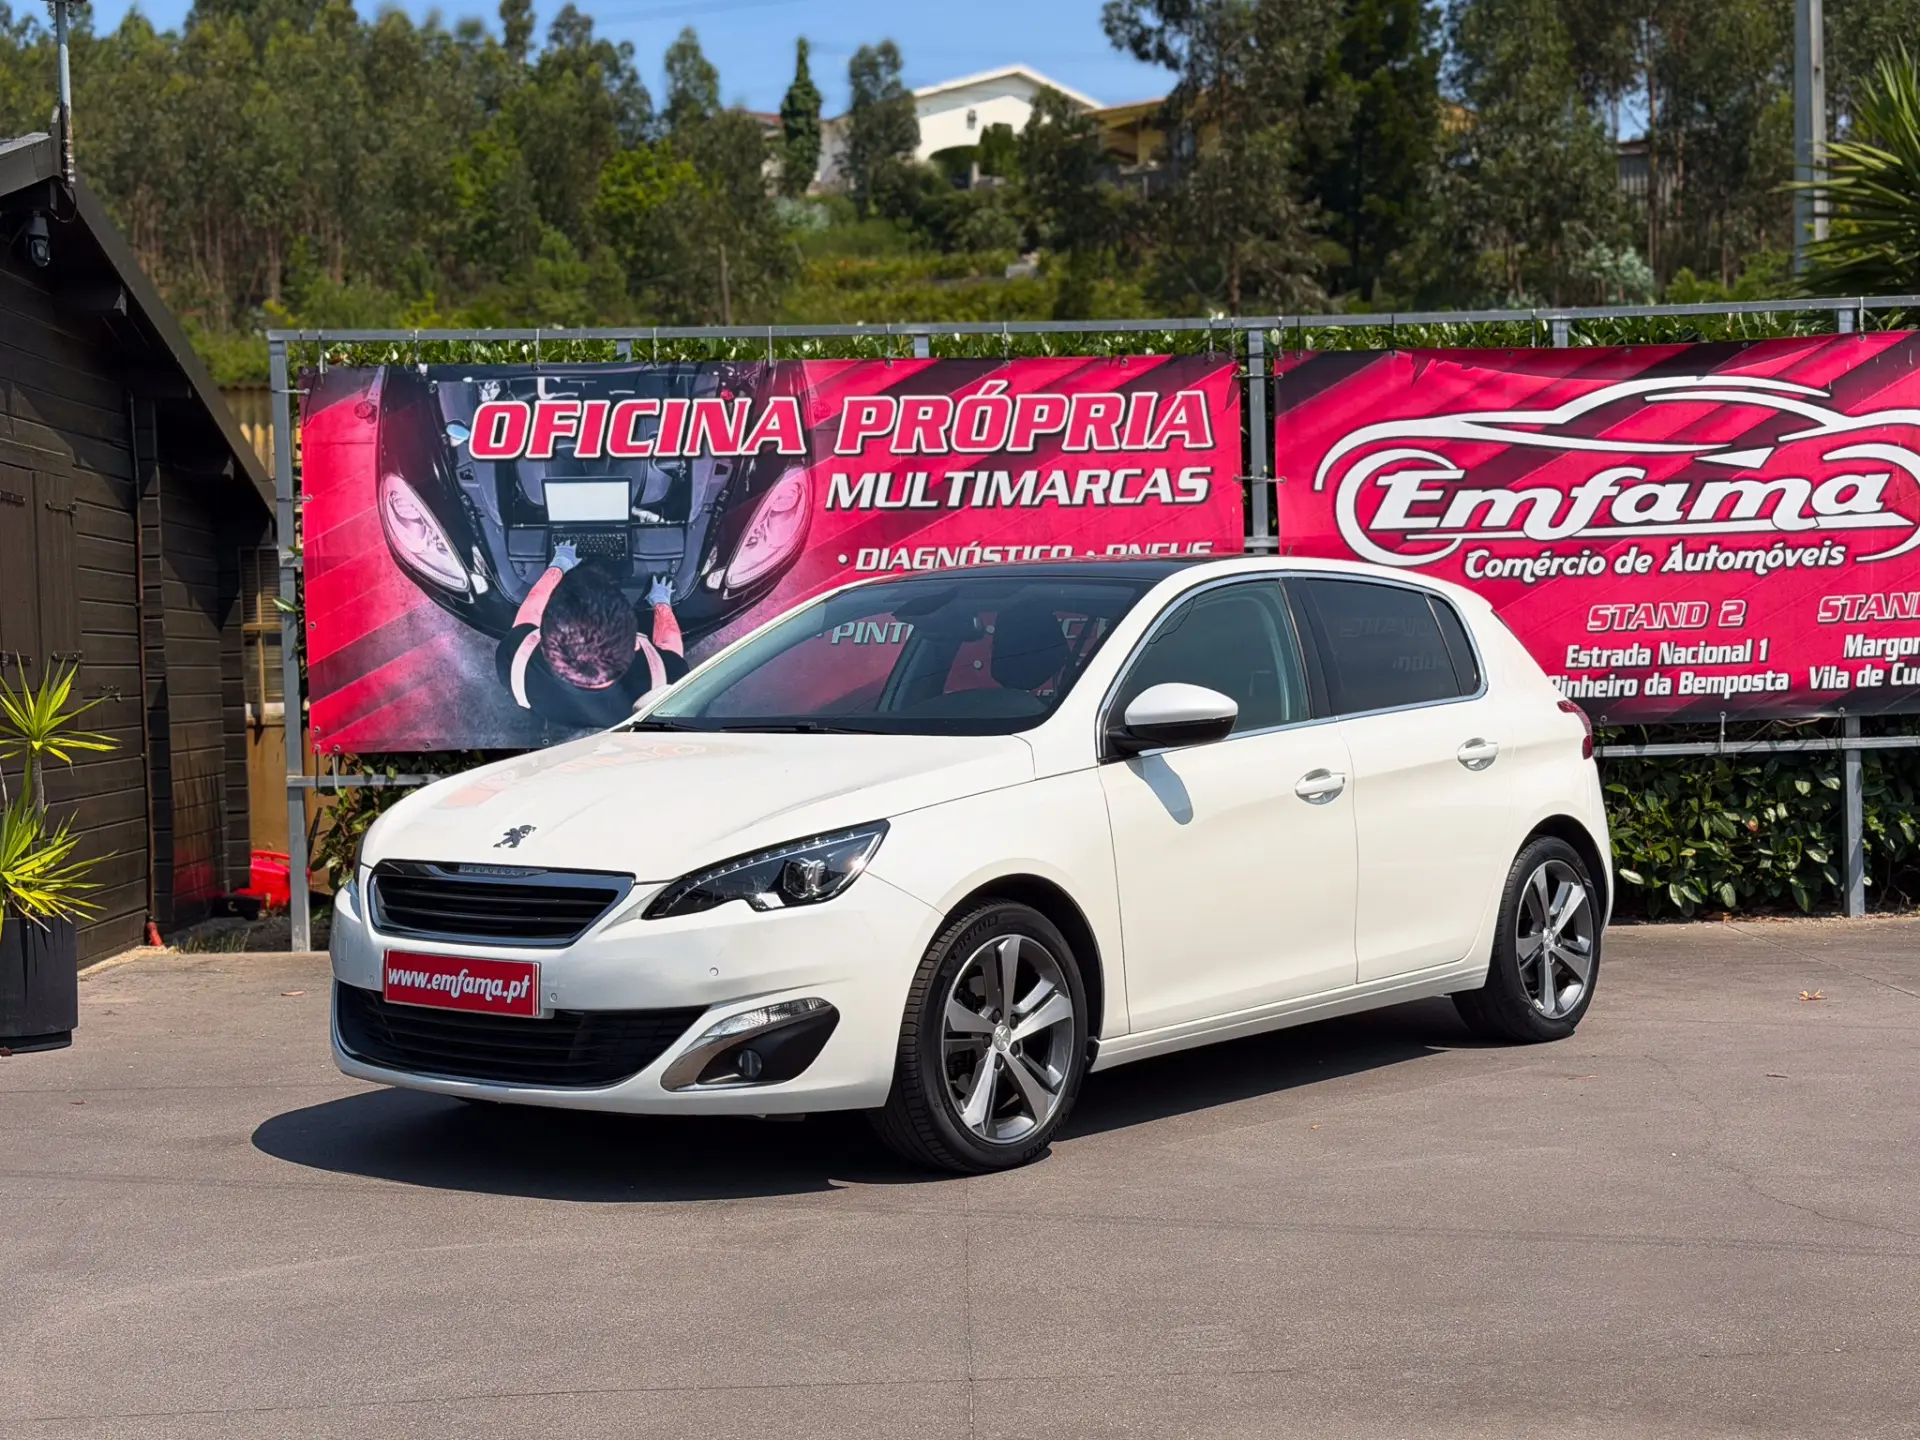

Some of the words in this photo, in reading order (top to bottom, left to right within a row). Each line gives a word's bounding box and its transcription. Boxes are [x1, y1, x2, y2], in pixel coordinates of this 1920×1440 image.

[469, 397, 806, 459] OFICINA
[834, 380, 1213, 454] PRÓPRIA
[825, 467, 1211, 509] MULTIMARCAS
[1368, 467, 1894, 540] Emfama
[1465, 549, 1605, 583] Comércio
[1614, 547, 1650, 574] de
[1660, 540, 1844, 575] Automóveis
[1587, 601, 1709, 632] STAND
[1718, 599, 1747, 627] 2
[1817, 591, 1920, 622] STAN
[1565, 643, 1651, 668] Estrada
[1658, 639, 1751, 665] Nacional
[1758, 638, 1768, 661] 1
[1645, 672, 1671, 695] da
[1678, 671, 1789, 699] Bemposta
[1809, 665, 1850, 689] Vila
[1856, 664, 1884, 687] de
[1890, 662, 1920, 686] Cu
[388, 966, 530, 1003] www.emfama.pt
